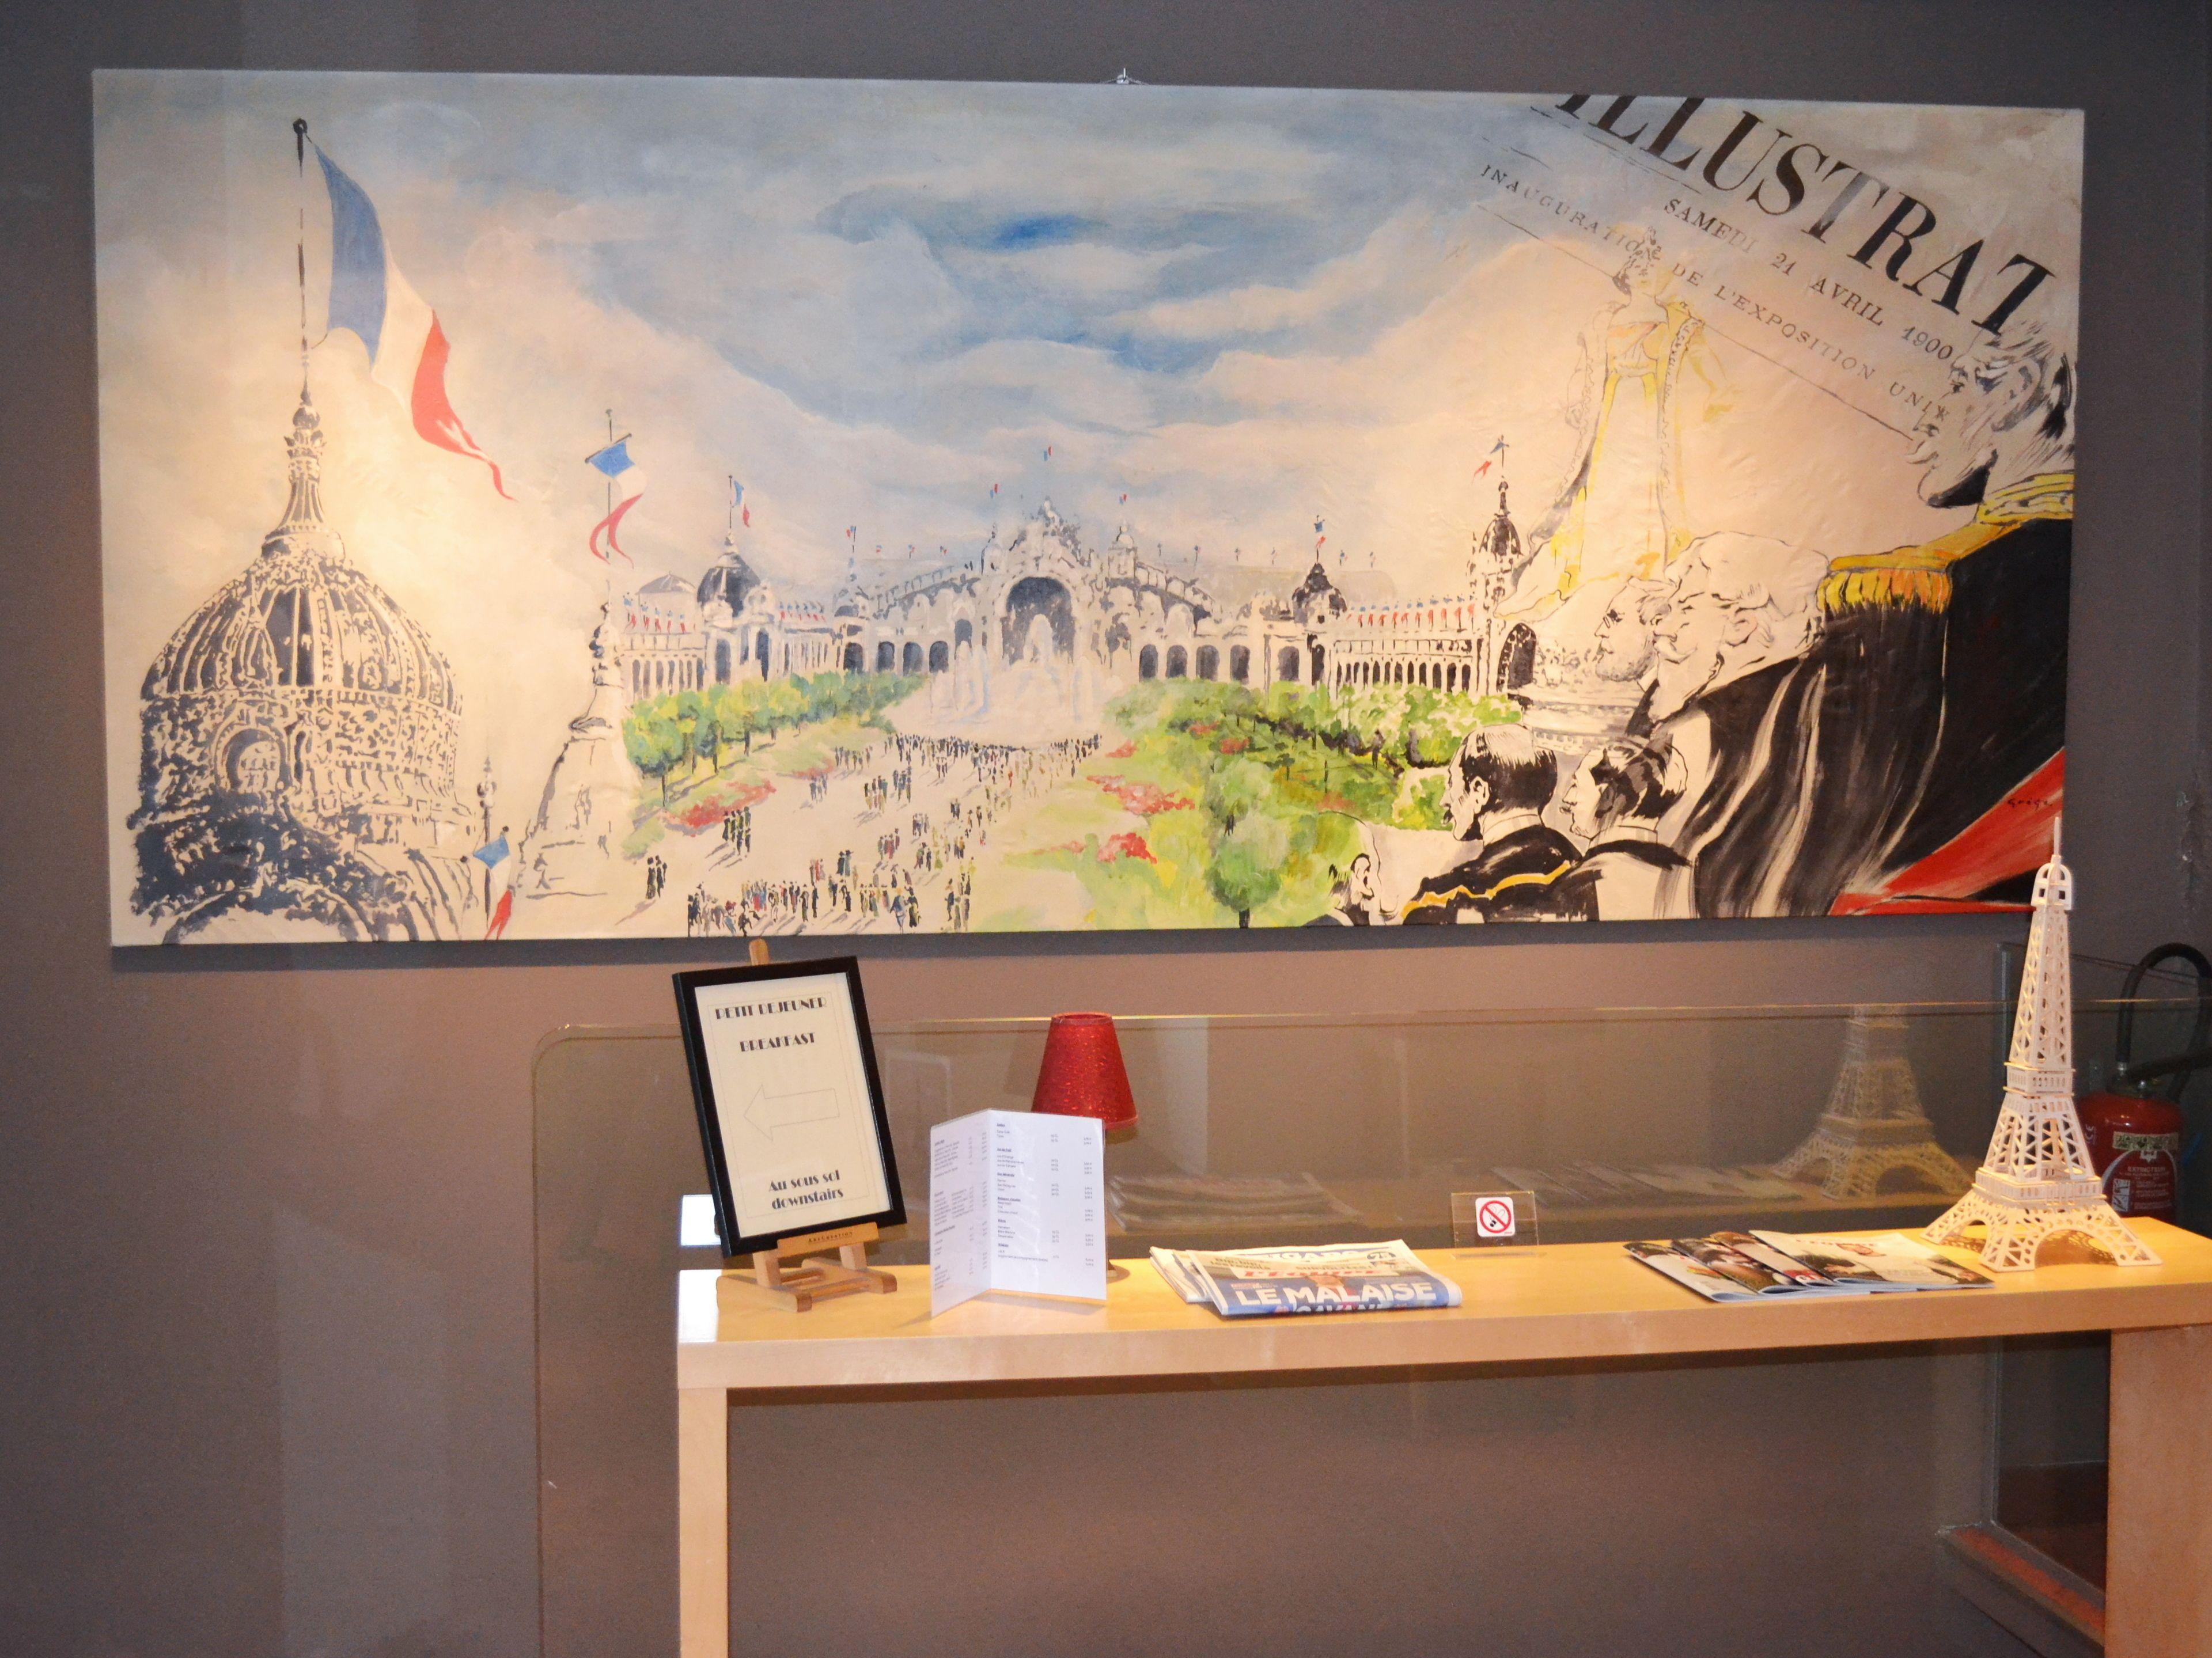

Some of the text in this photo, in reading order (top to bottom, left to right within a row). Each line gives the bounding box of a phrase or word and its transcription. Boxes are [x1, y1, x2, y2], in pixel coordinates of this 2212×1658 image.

[1663, 198, 1758, 253] SAMEDI
[1809, 278, 1883, 326] AVRIL
[1902, 326, 1953, 360] 1900
[1671, 263, 1703, 286] DE
[1714, 285, 1875, 380] L'EXPOSITION
[715, 997, 827, 1019] PETIT DEJEUNER
[740, 1032, 816, 1052] BREAKFAST
[769, 1169, 840, 1192] Au sous sol
[772, 1188, 844, 1209] downstairs
[1234, 1288, 1282, 1306] LE
[1282, 1282, 1437, 1303] MALAISE
